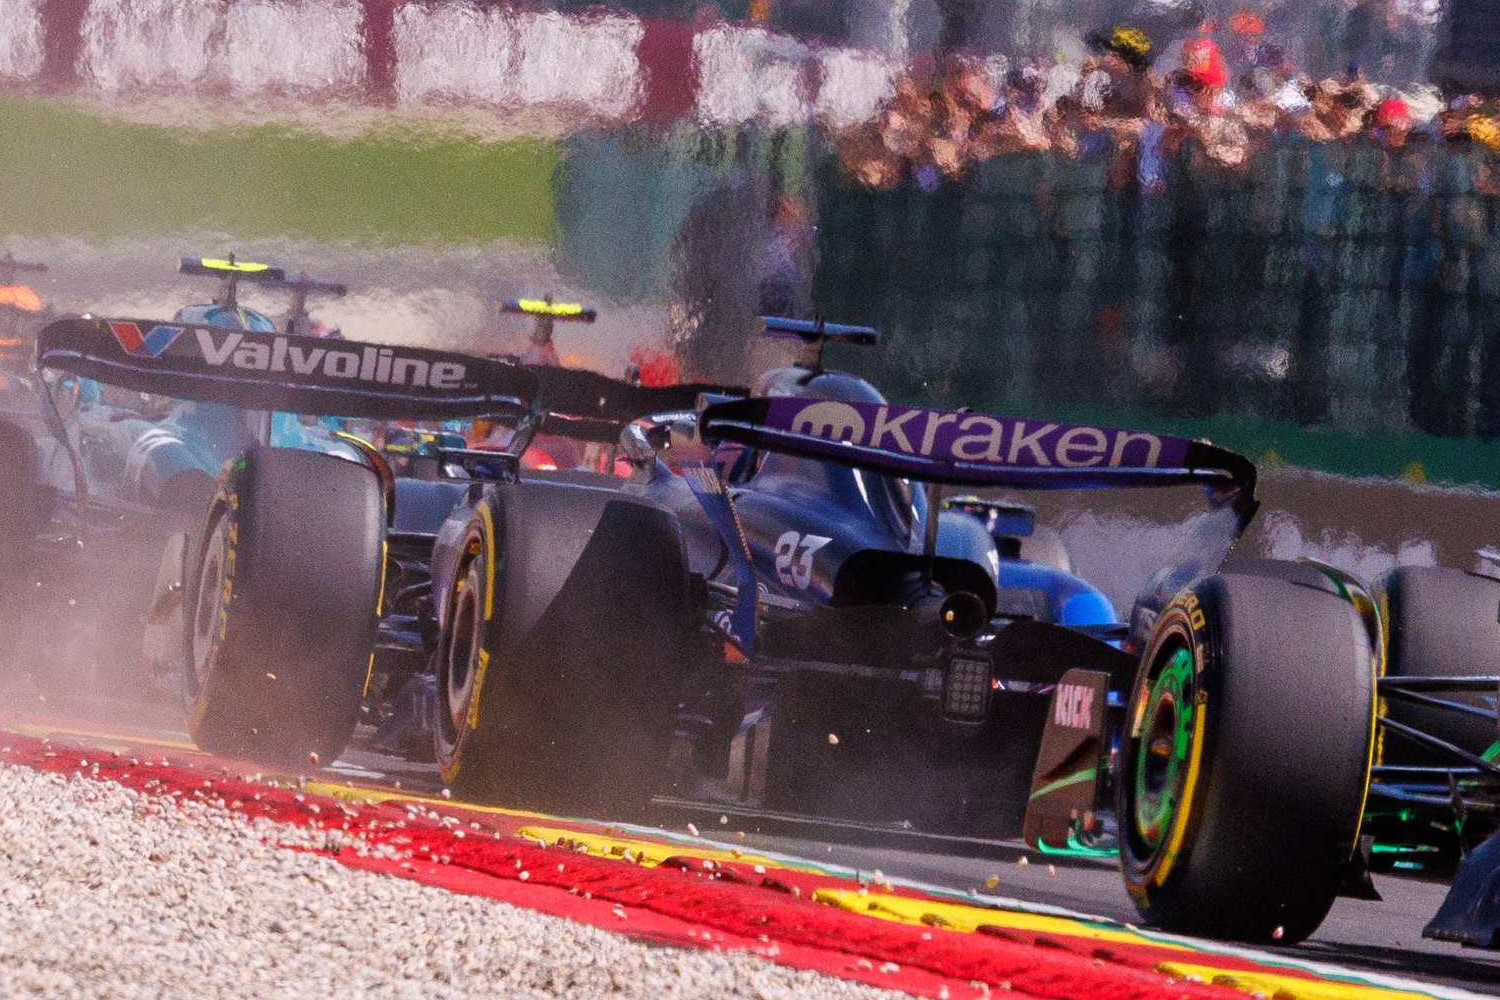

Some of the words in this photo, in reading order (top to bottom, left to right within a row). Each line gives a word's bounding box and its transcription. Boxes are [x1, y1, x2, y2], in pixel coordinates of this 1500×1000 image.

[195, 327, 467, 390] Valvoline
[869, 404, 1164, 469] kraken
[775, 530, 833, 590] 23
[1055, 683, 1095, 730] KICK
